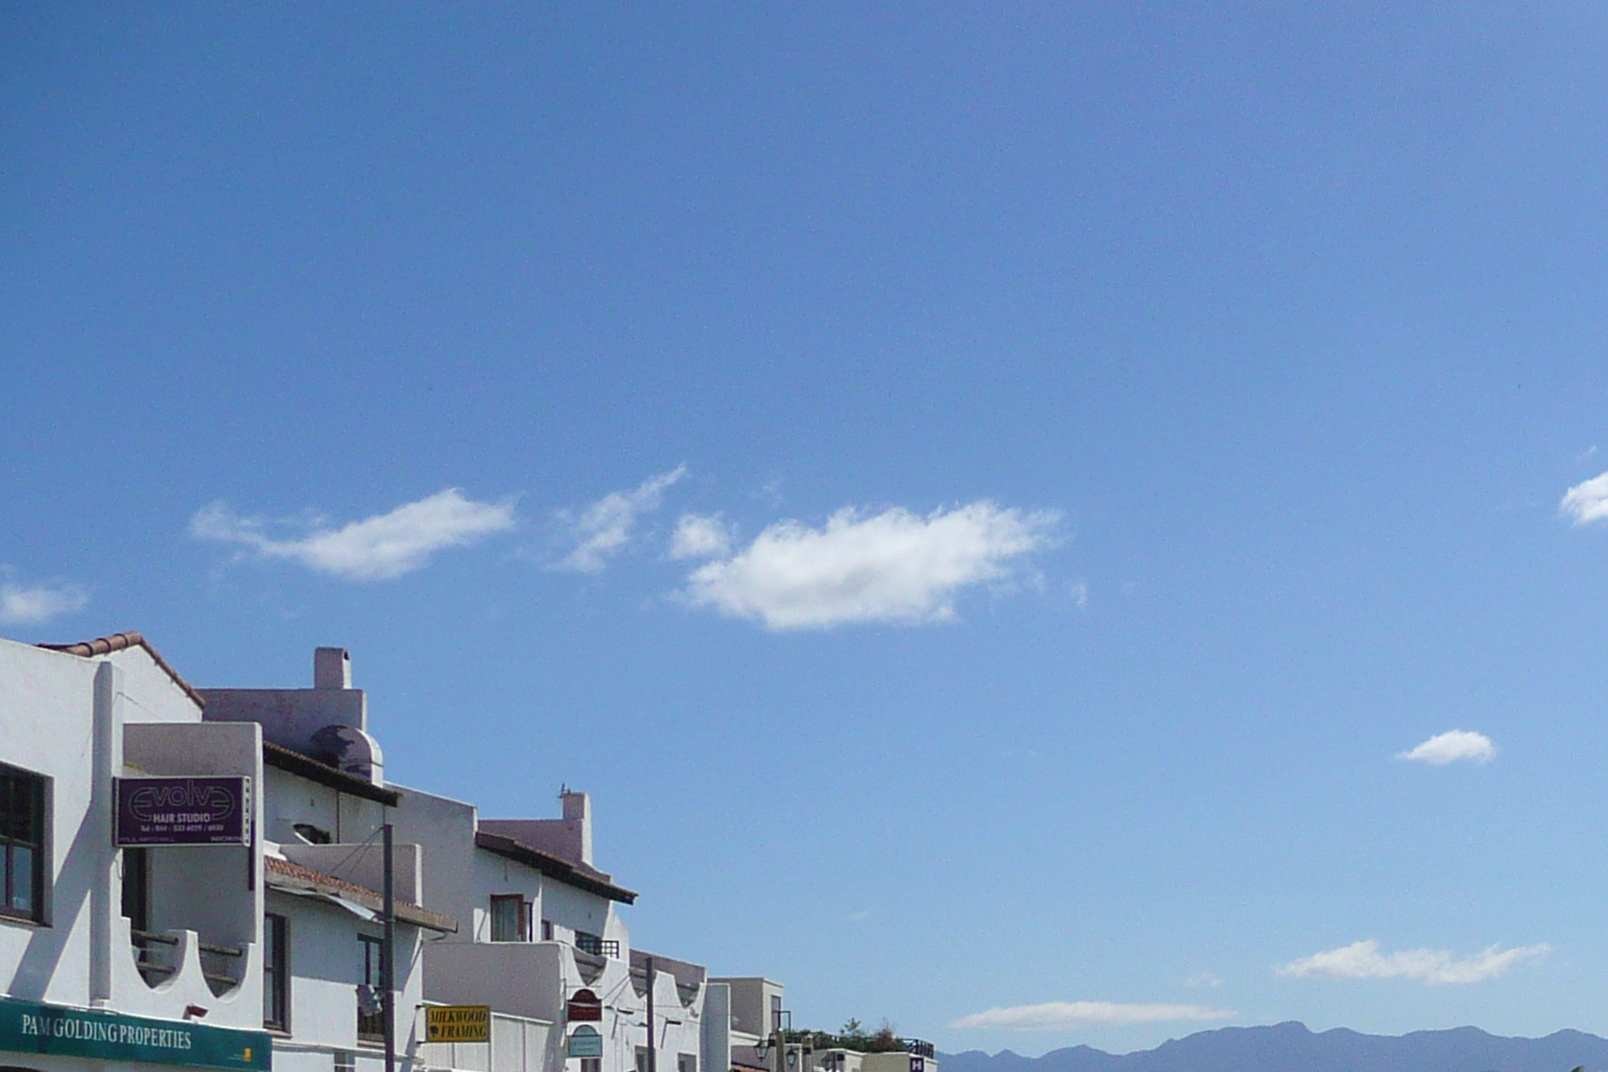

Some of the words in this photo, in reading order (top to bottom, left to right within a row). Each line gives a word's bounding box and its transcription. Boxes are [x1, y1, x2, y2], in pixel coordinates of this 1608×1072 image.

[153, 813, 175, 824] HAIR
[177, 813, 211, 824] STUDIO
[430, 1010, 487, 1023] MILKWOOD
[22, 1014, 51, 1036] PAM
[53, 1018, 118, 1043] GOLDING
[119, 1025, 192, 1050] PROPERTIES
[440, 1025, 487, 1038] FRAMING
